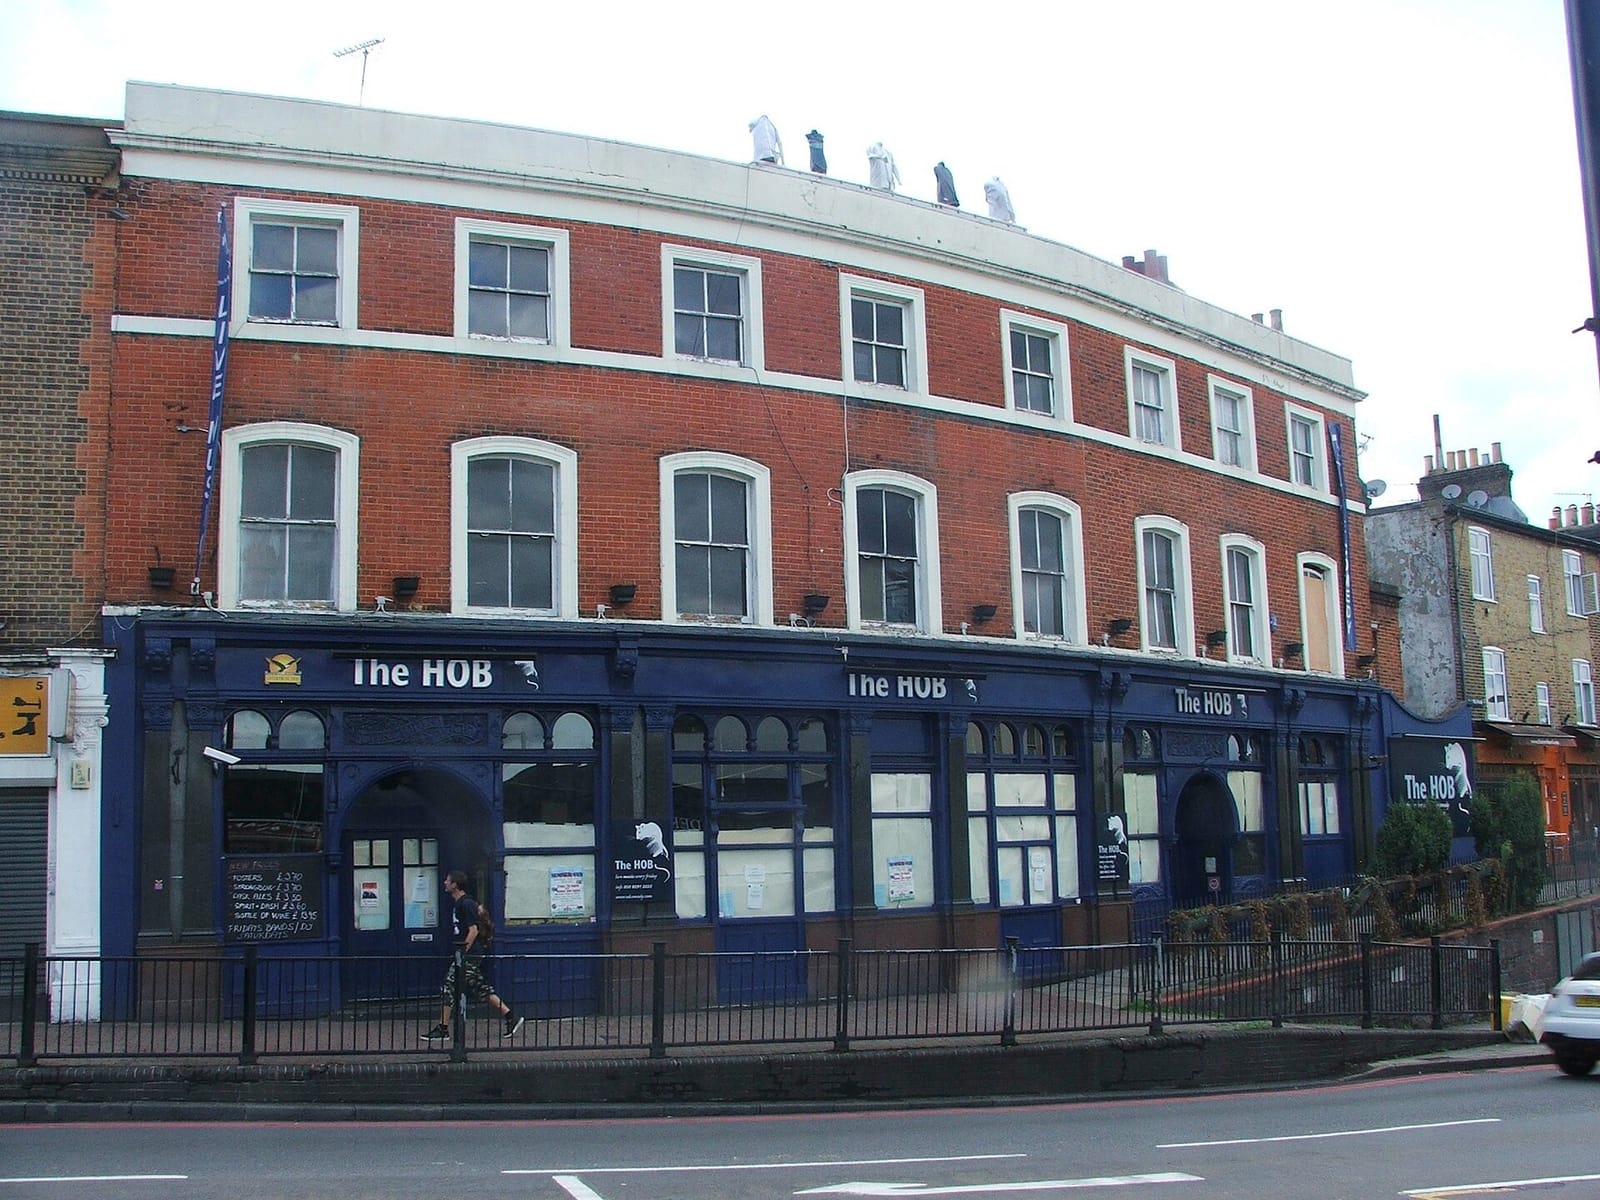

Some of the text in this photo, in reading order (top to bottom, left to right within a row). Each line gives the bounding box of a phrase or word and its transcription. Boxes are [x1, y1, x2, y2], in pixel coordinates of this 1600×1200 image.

[212, 295, 228, 401] LIVE
[36, 681, 43, 690] 5
[354, 658, 493, 688] The HOB
[849, 673, 947, 699] The HOB
[1175, 687, 1232, 715] The HOB
[1404, 774, 1456, 800] The HOB
[615, 859, 654, 870] The HOB
[260, 911, 269, 919] OF
[271, 911, 291, 920] WINE
